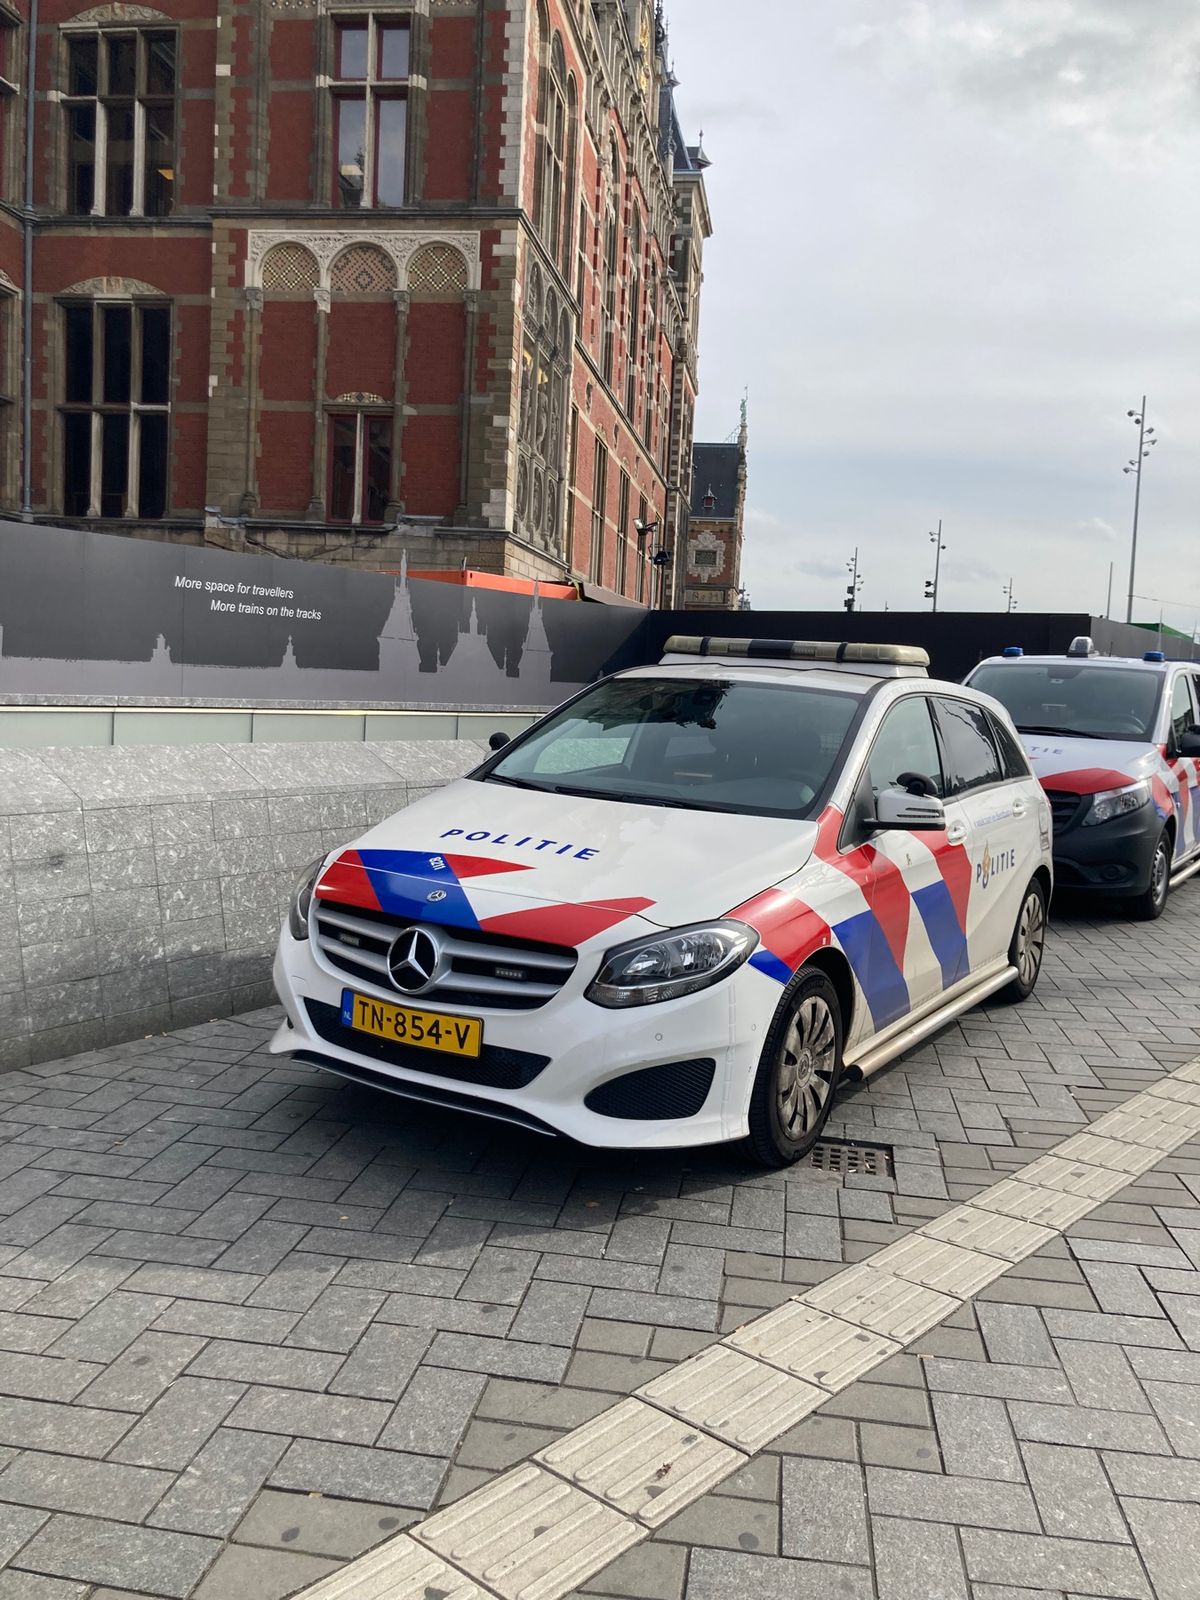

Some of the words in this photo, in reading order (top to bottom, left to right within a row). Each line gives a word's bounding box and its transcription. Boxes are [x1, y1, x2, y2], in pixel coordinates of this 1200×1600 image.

[174, 575, 202, 590] More
[204, 580, 235, 593] space
[237, 582, 251, 594] for
[252, 584, 294, 599] travellers
[210, 599, 236, 612] More
[238, 602, 265, 615] trains
[266, 607, 278, 616] on
[280, 606, 294, 618] the
[296, 607, 322, 620] tracks
[439, 828, 601, 861] POLITIE
[343, 1011, 352, 1021] NL
[358, 1000, 471, 1050] TN-854-V
